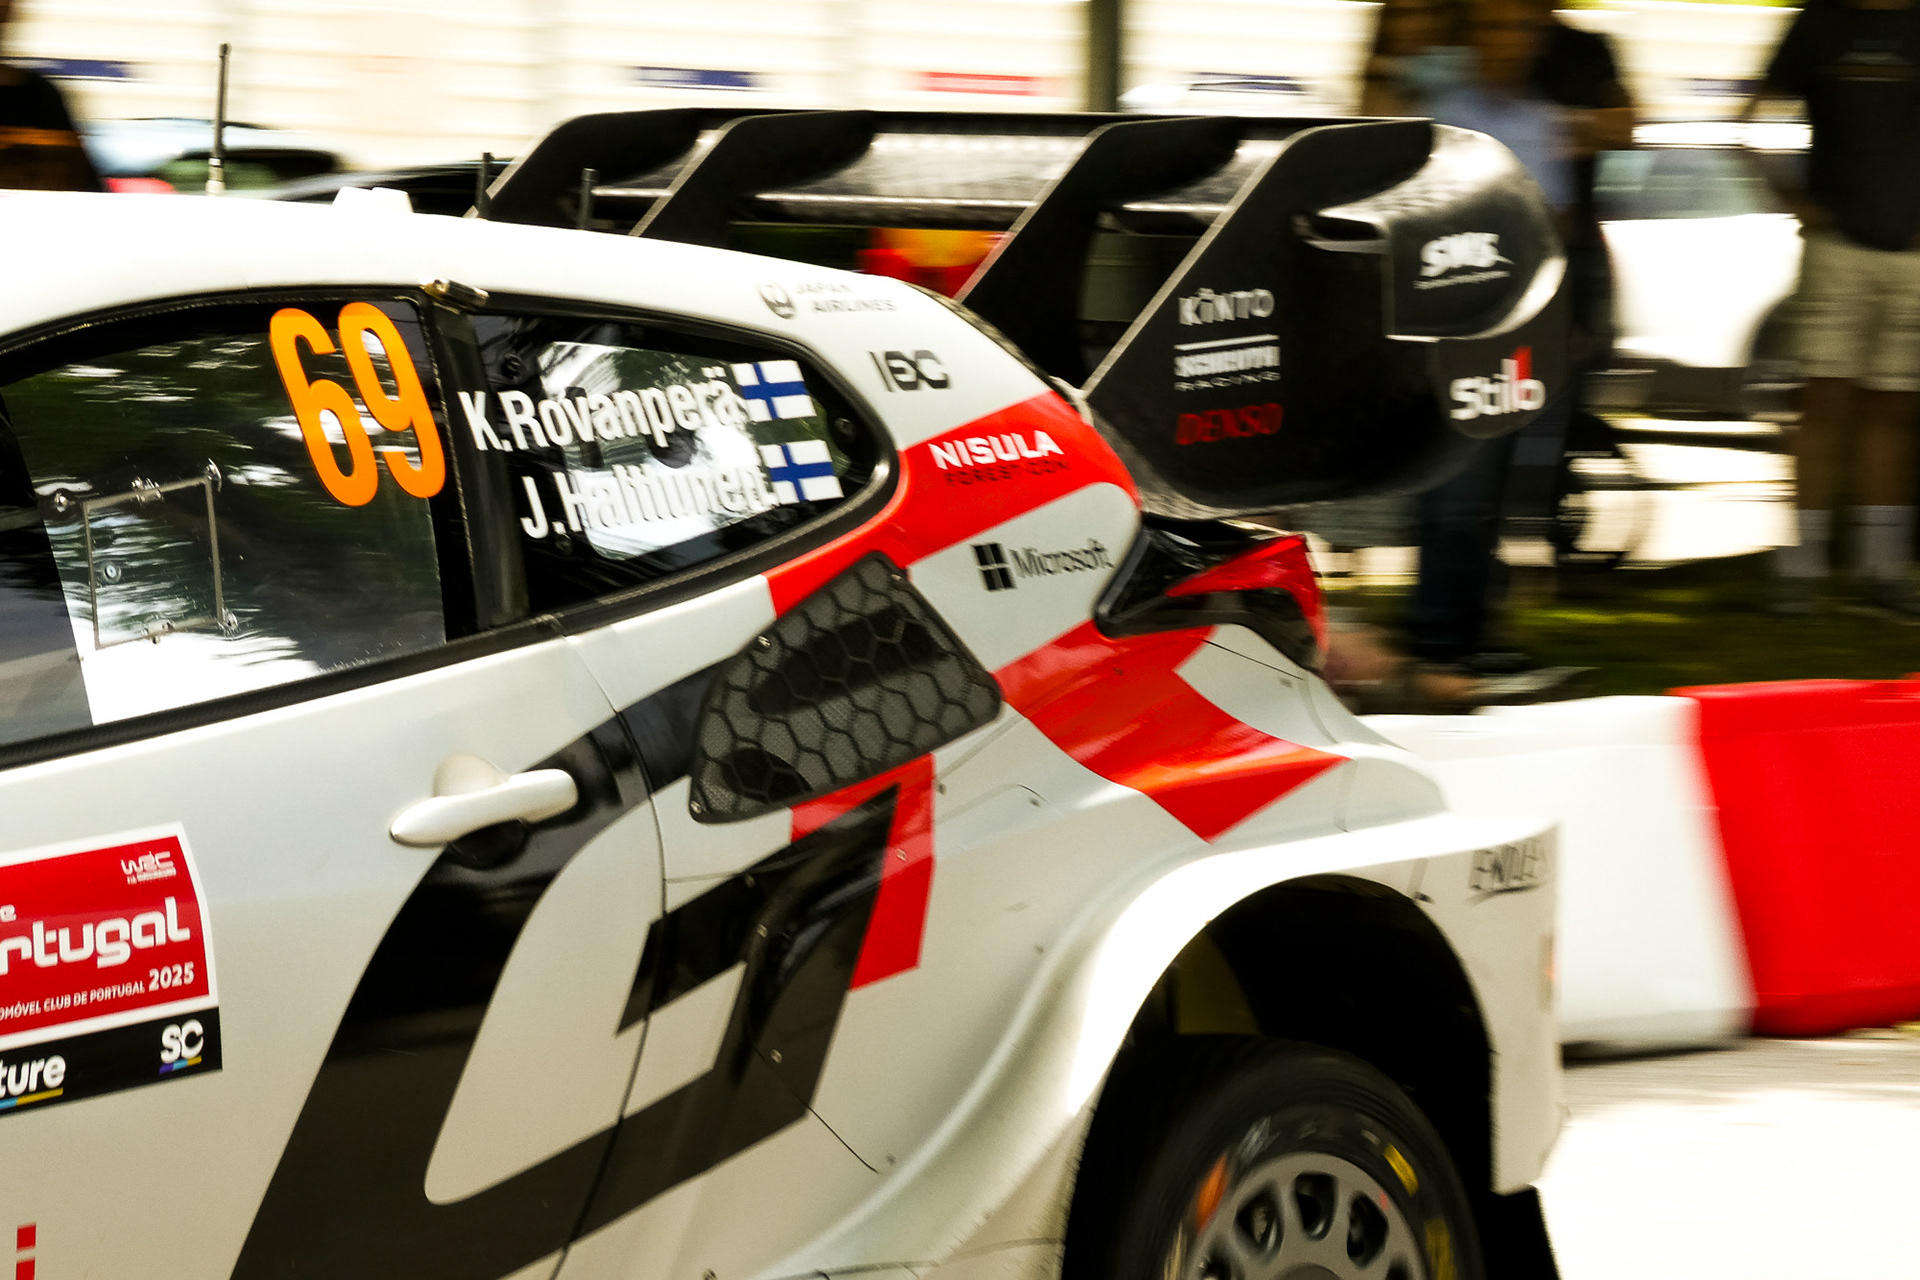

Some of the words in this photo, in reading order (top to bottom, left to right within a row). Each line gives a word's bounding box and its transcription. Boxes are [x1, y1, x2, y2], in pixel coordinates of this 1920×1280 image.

[811, 299, 897, 312] AIRLINES
[269, 301, 446, 507] 69
[1451, 346, 1546, 420] Stilo
[458, 366, 748, 452] K.Rovanperä
[1176, 403, 1284, 445] DENSO
[928, 430, 1065, 470] NISULA
[1009, 537, 1115, 578] Microsoft
[43, 994, 71, 1012] CLUB
[73, 991, 88, 1007] DE
[90, 980, 145, 1001] PORTUGAL
[148, 961, 195, 992] 2025
[160, 1019, 204, 1060] SC
